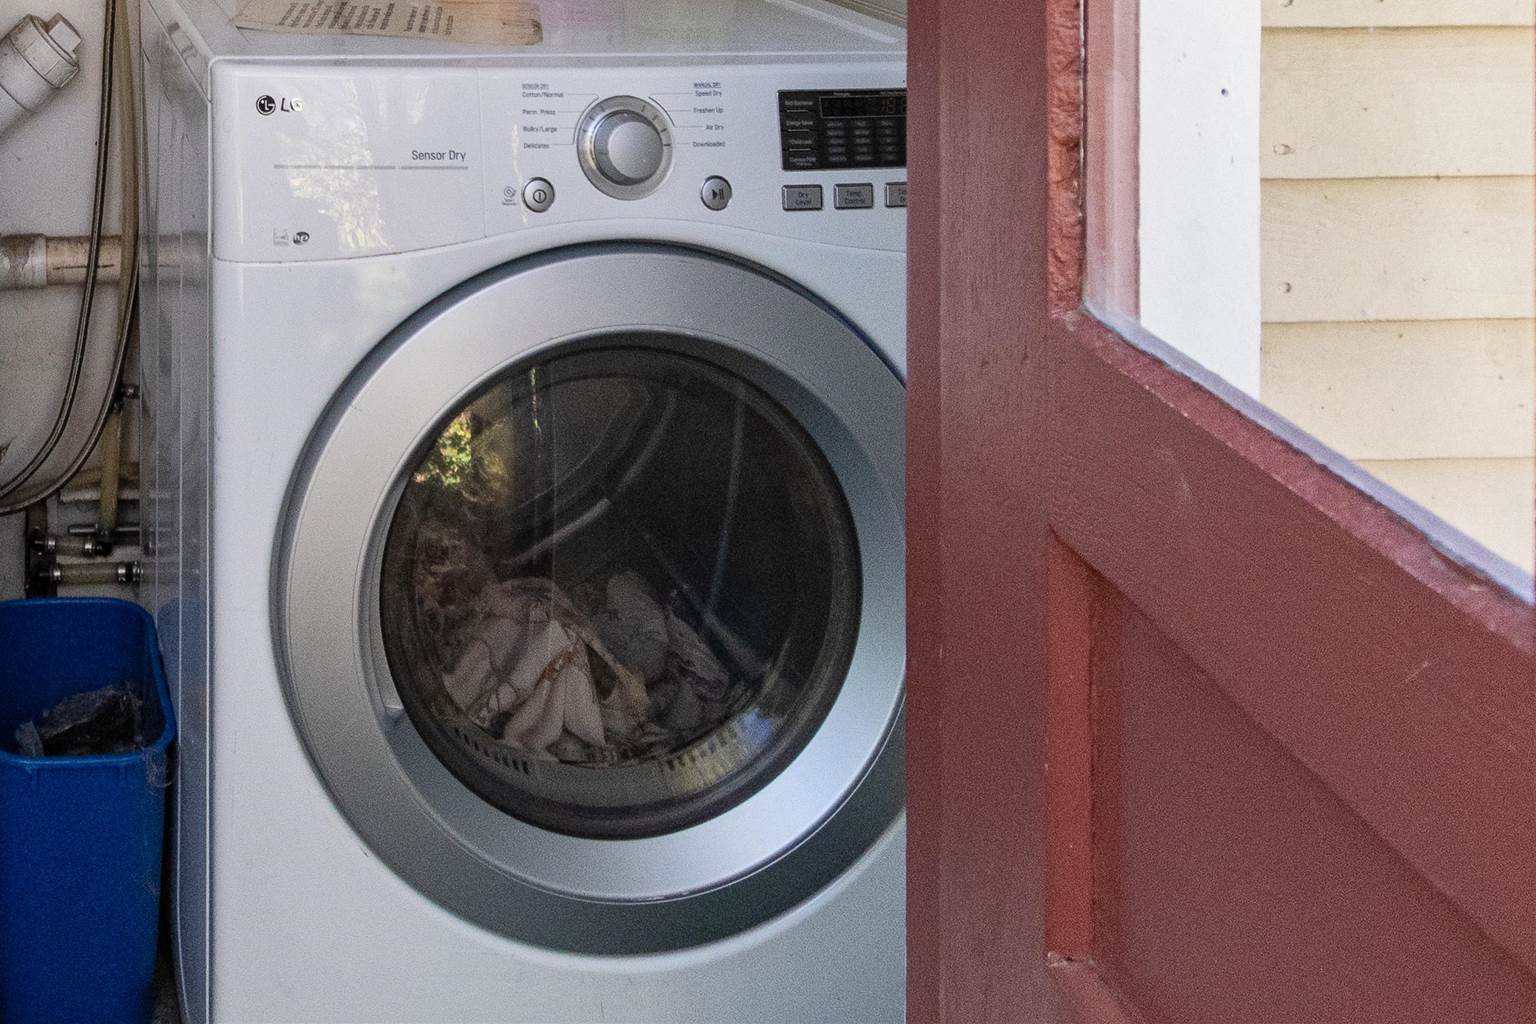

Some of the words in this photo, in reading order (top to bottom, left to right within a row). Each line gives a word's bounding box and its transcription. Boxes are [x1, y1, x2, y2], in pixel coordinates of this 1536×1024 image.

[280, 97, 304, 113] LG
[523, 126, 558, 134] Bulky/Large
[523, 142, 551, 150] Delicates
[411, 150, 447, 161] Sensor
[448, 150, 467, 163] Dry
